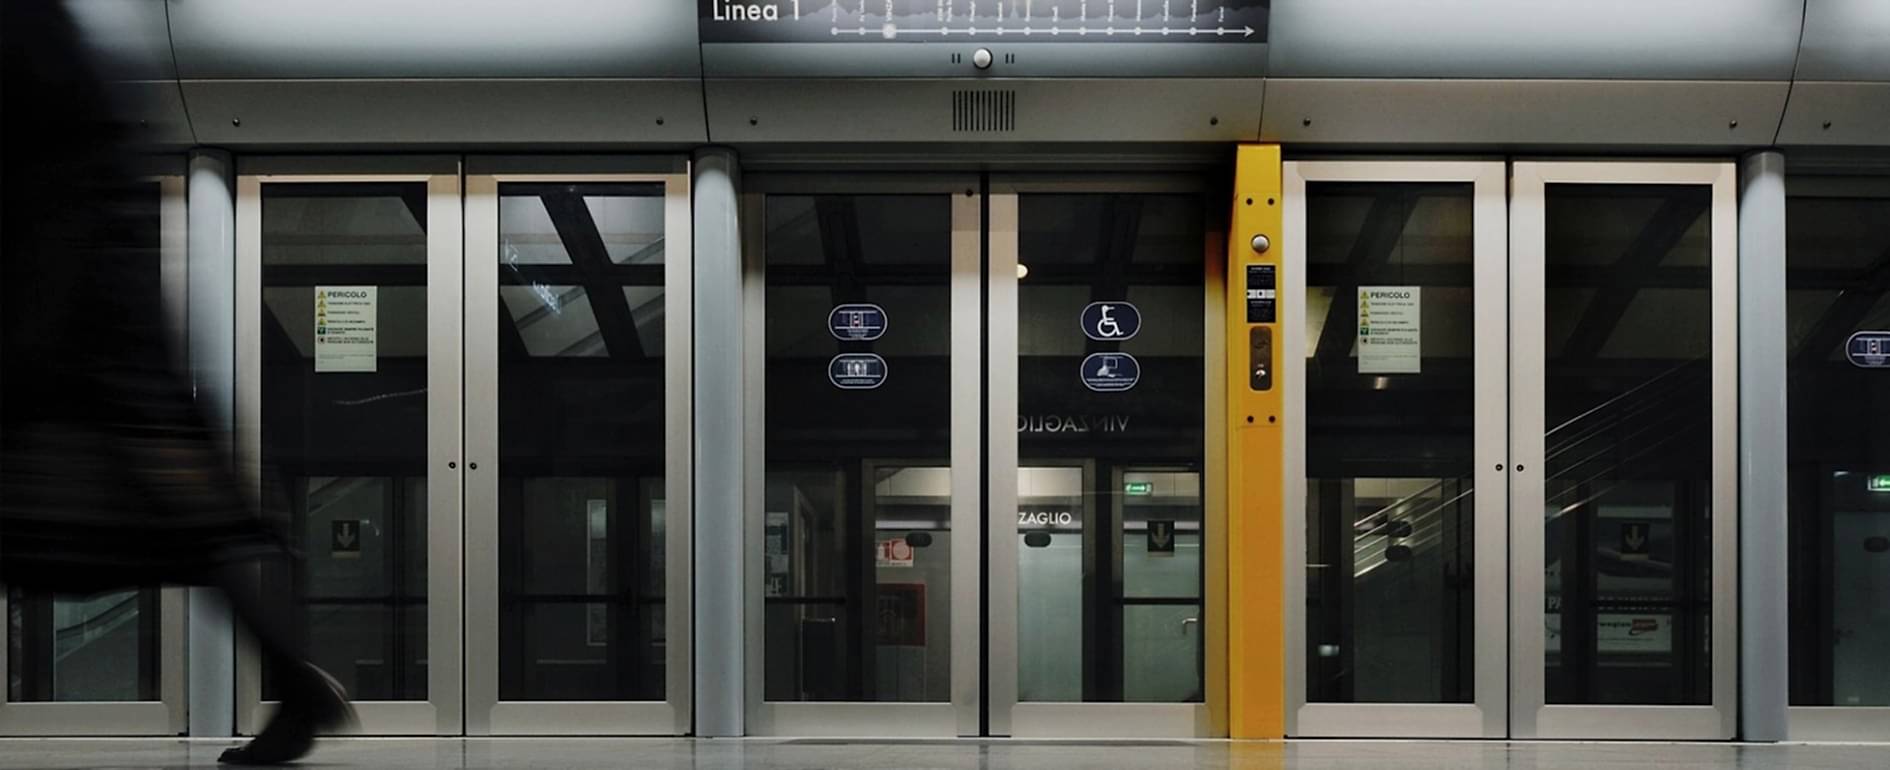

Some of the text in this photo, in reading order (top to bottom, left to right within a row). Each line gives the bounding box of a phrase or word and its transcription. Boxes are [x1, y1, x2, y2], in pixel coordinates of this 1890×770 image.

[713, 0, 799, 21] Linea 1
[327, 291, 367, 299] PERICOLO
[1370, 291, 1410, 299] PERICOLO
[1018, 511, 1072, 525] ZAGLIO
